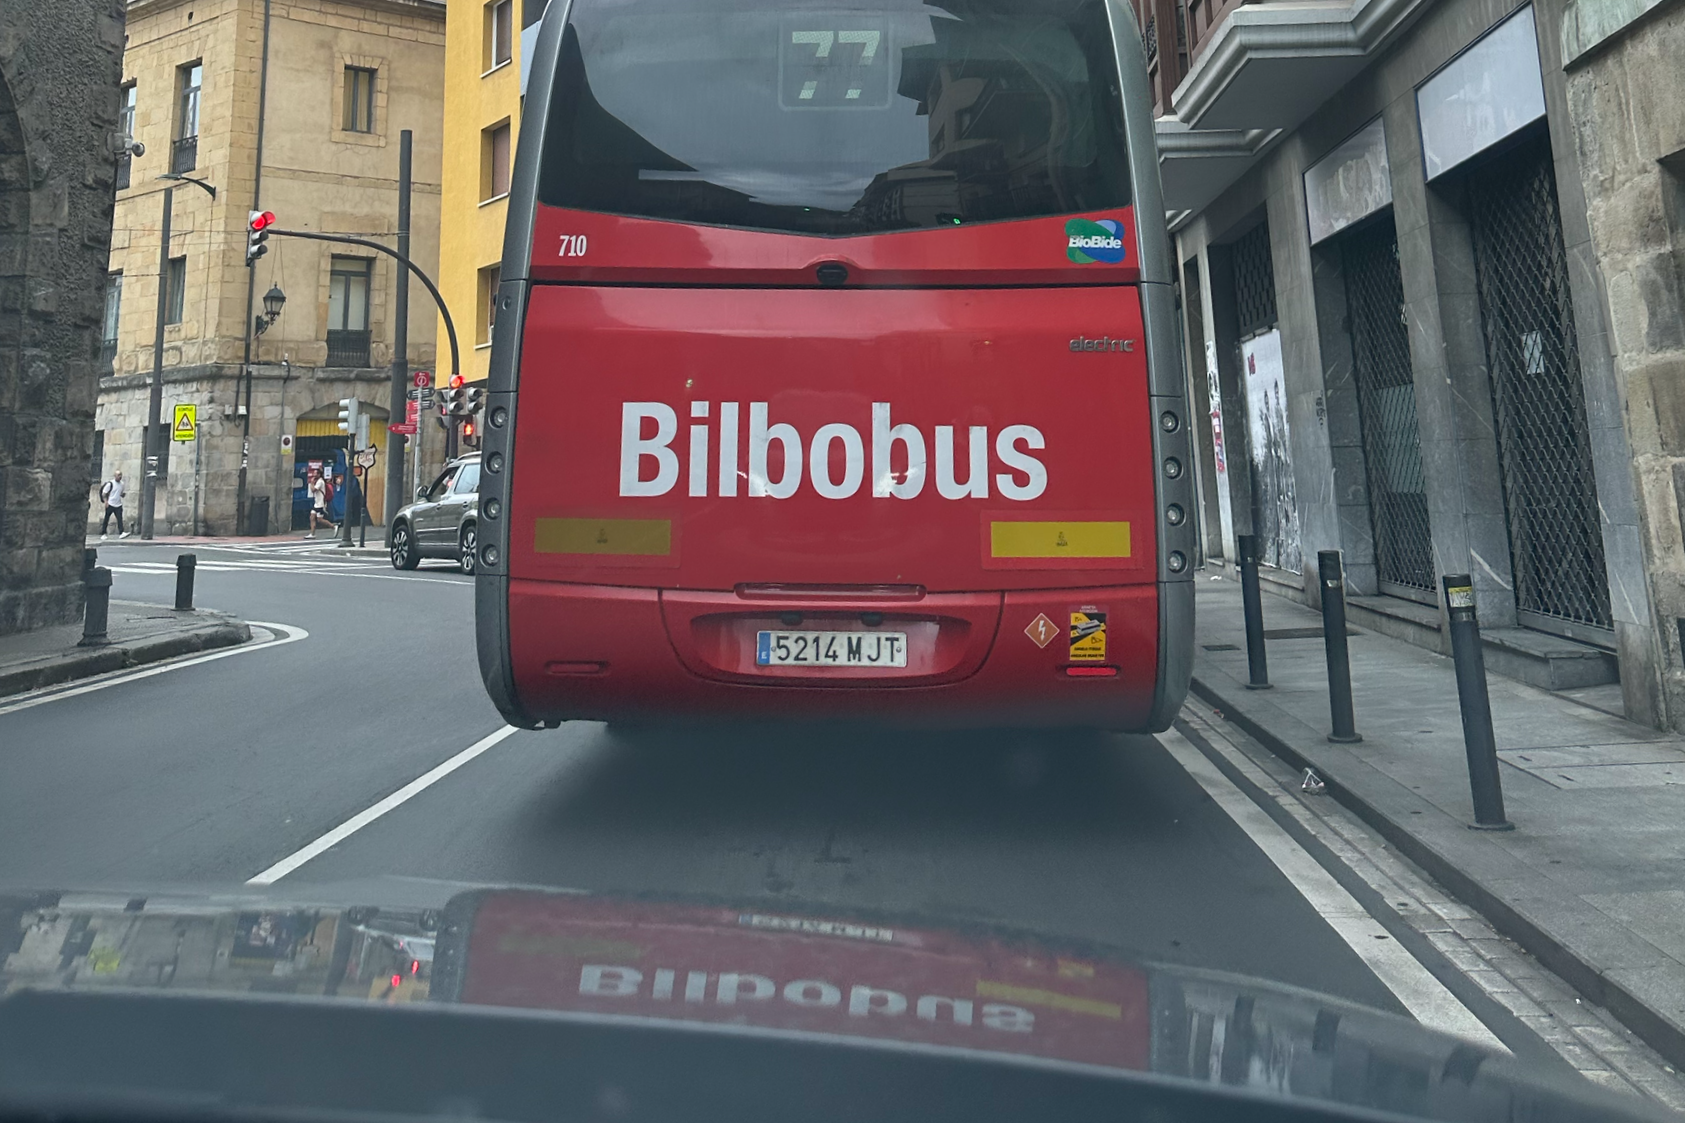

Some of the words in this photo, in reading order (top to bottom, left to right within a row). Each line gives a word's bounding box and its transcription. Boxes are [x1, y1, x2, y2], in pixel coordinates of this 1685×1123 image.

[792, 30, 881, 99] 77
[558, 234, 587, 257] 710
[1068, 235, 1122, 249] BioBide
[1069, 335, 1135, 352] electric
[618, 400, 1048, 501] Bilbobus
[761, 651, 768, 659] E
[776, 635, 839, 662] 5214
[847, 636, 900, 663] MJT
